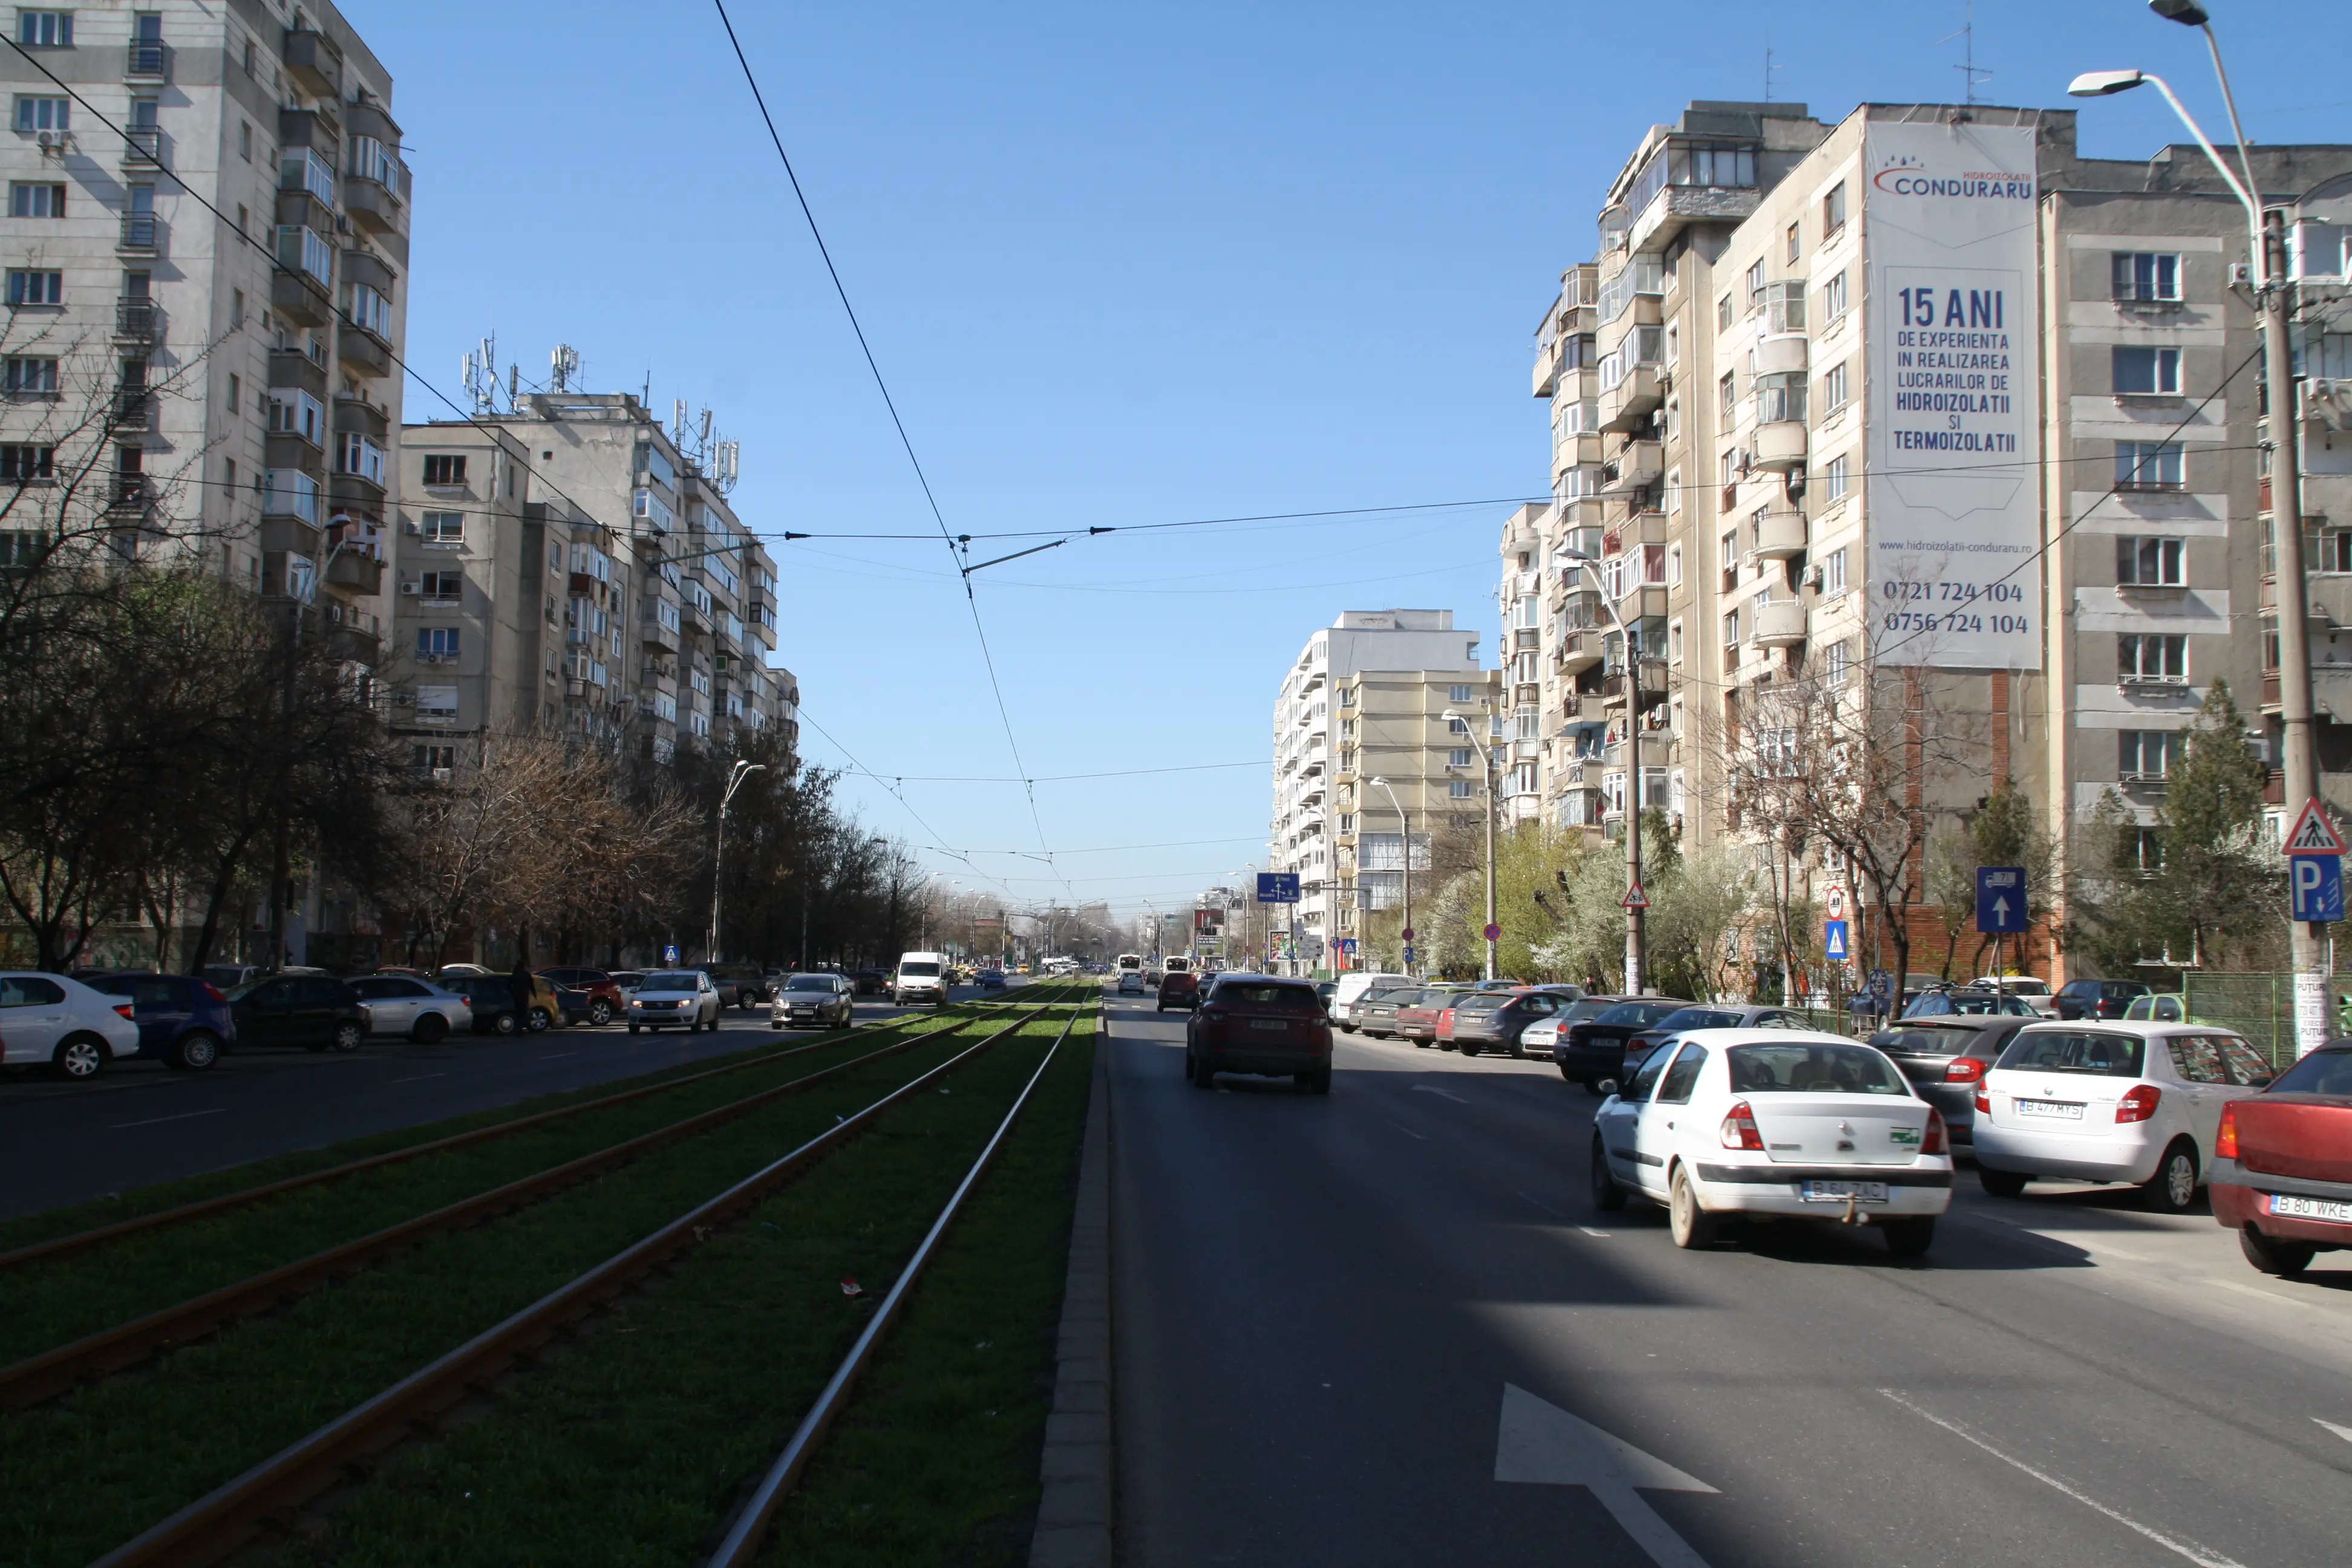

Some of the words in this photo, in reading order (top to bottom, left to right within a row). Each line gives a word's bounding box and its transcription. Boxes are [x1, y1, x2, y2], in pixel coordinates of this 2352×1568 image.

[1963, 172, 2031, 181] HIDROIZOLATII
[1895, 178, 2031, 199] CONDURARU
[1899, 287, 1933, 327] 15
[1944, 289, 2002, 328] ANI
[1898, 332, 1915, 347] DE
[1919, 332, 2009, 349] EXPERIENTA
[1898, 351, 1912, 367] IN
[1918, 352, 2009, 370] REALIZAREA
[1898, 372, 1985, 390] LUCRARILOR
[1991, 375, 2008, 390] DE
[1897, 392, 2010, 413] HIDROIZOLATII
[1949, 414, 1960, 430] SI
[1894, 431, 2014, 452] TERMOIZOLATII
[1879, 540, 2032, 553] www.hidroizolatii-conduraru.ro
[1884, 581, 1930, 599] 0721
[1939, 583, 1976, 601] 724
[1985, 584, 2022, 602] 104
[1884, 613, 1937, 631] 0756
[1945, 614, 1982, 632] 724
[1990, 615, 2028, 633] 104
[2295, 861, 2321, 912] P
[2027, 1102, 2034, 1111] B
[1814, 1181, 1823, 1195] B
[2279, 1197, 2290, 1210] B
[2295, 1198, 2310, 1214] 80
[2316, 1201, 2348, 1218] WKE
